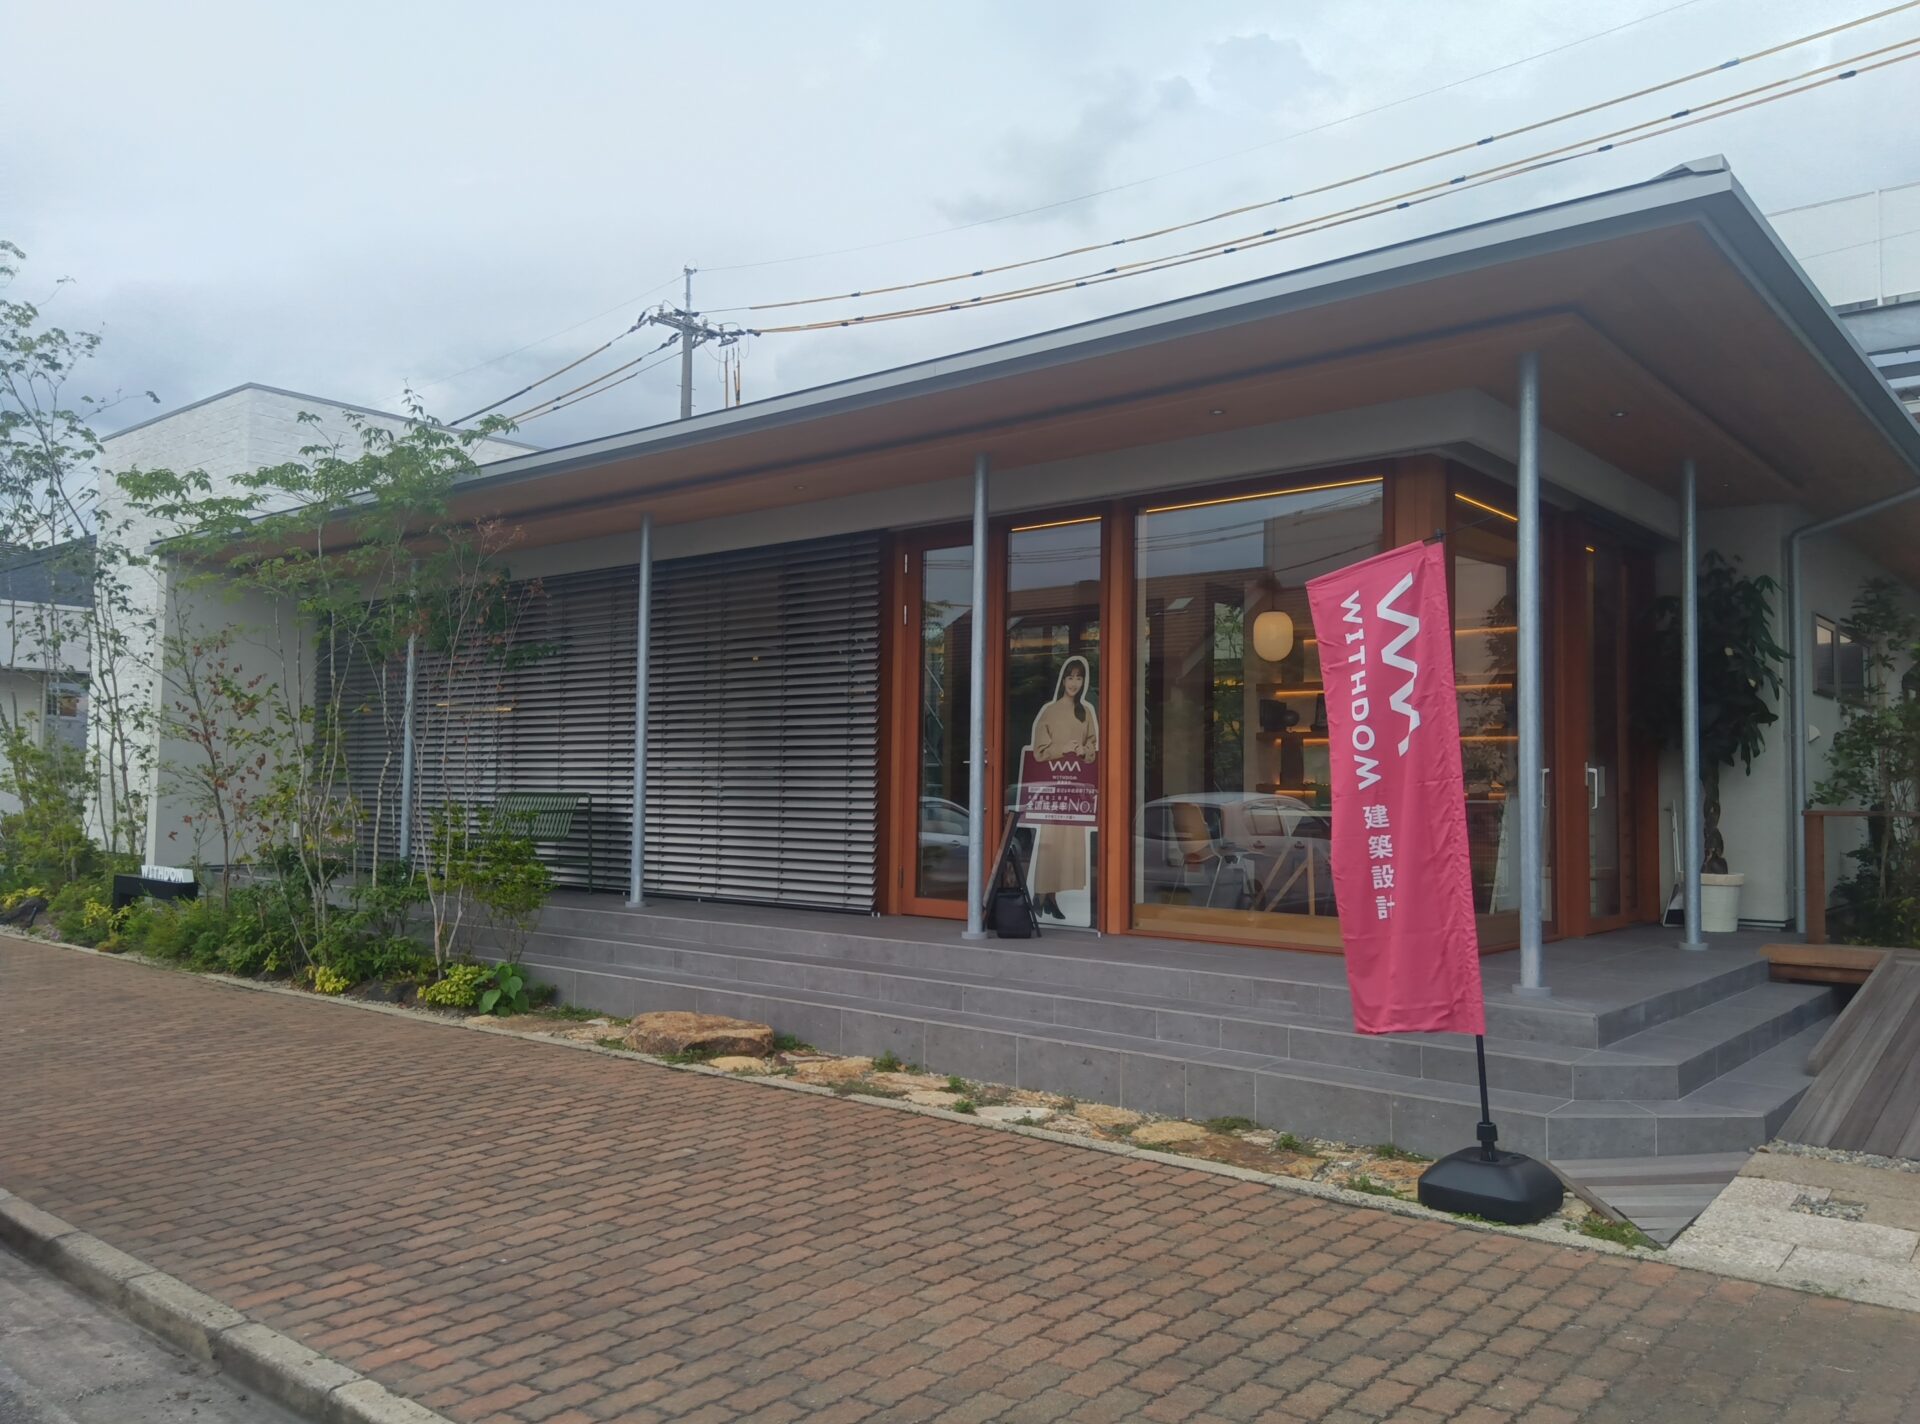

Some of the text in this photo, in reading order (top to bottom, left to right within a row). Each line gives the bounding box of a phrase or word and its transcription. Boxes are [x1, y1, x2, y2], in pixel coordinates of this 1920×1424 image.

[1340, 590, 1396, 920] WITHDOM 建築設計
[141, 865, 184, 882] WITHDOM
